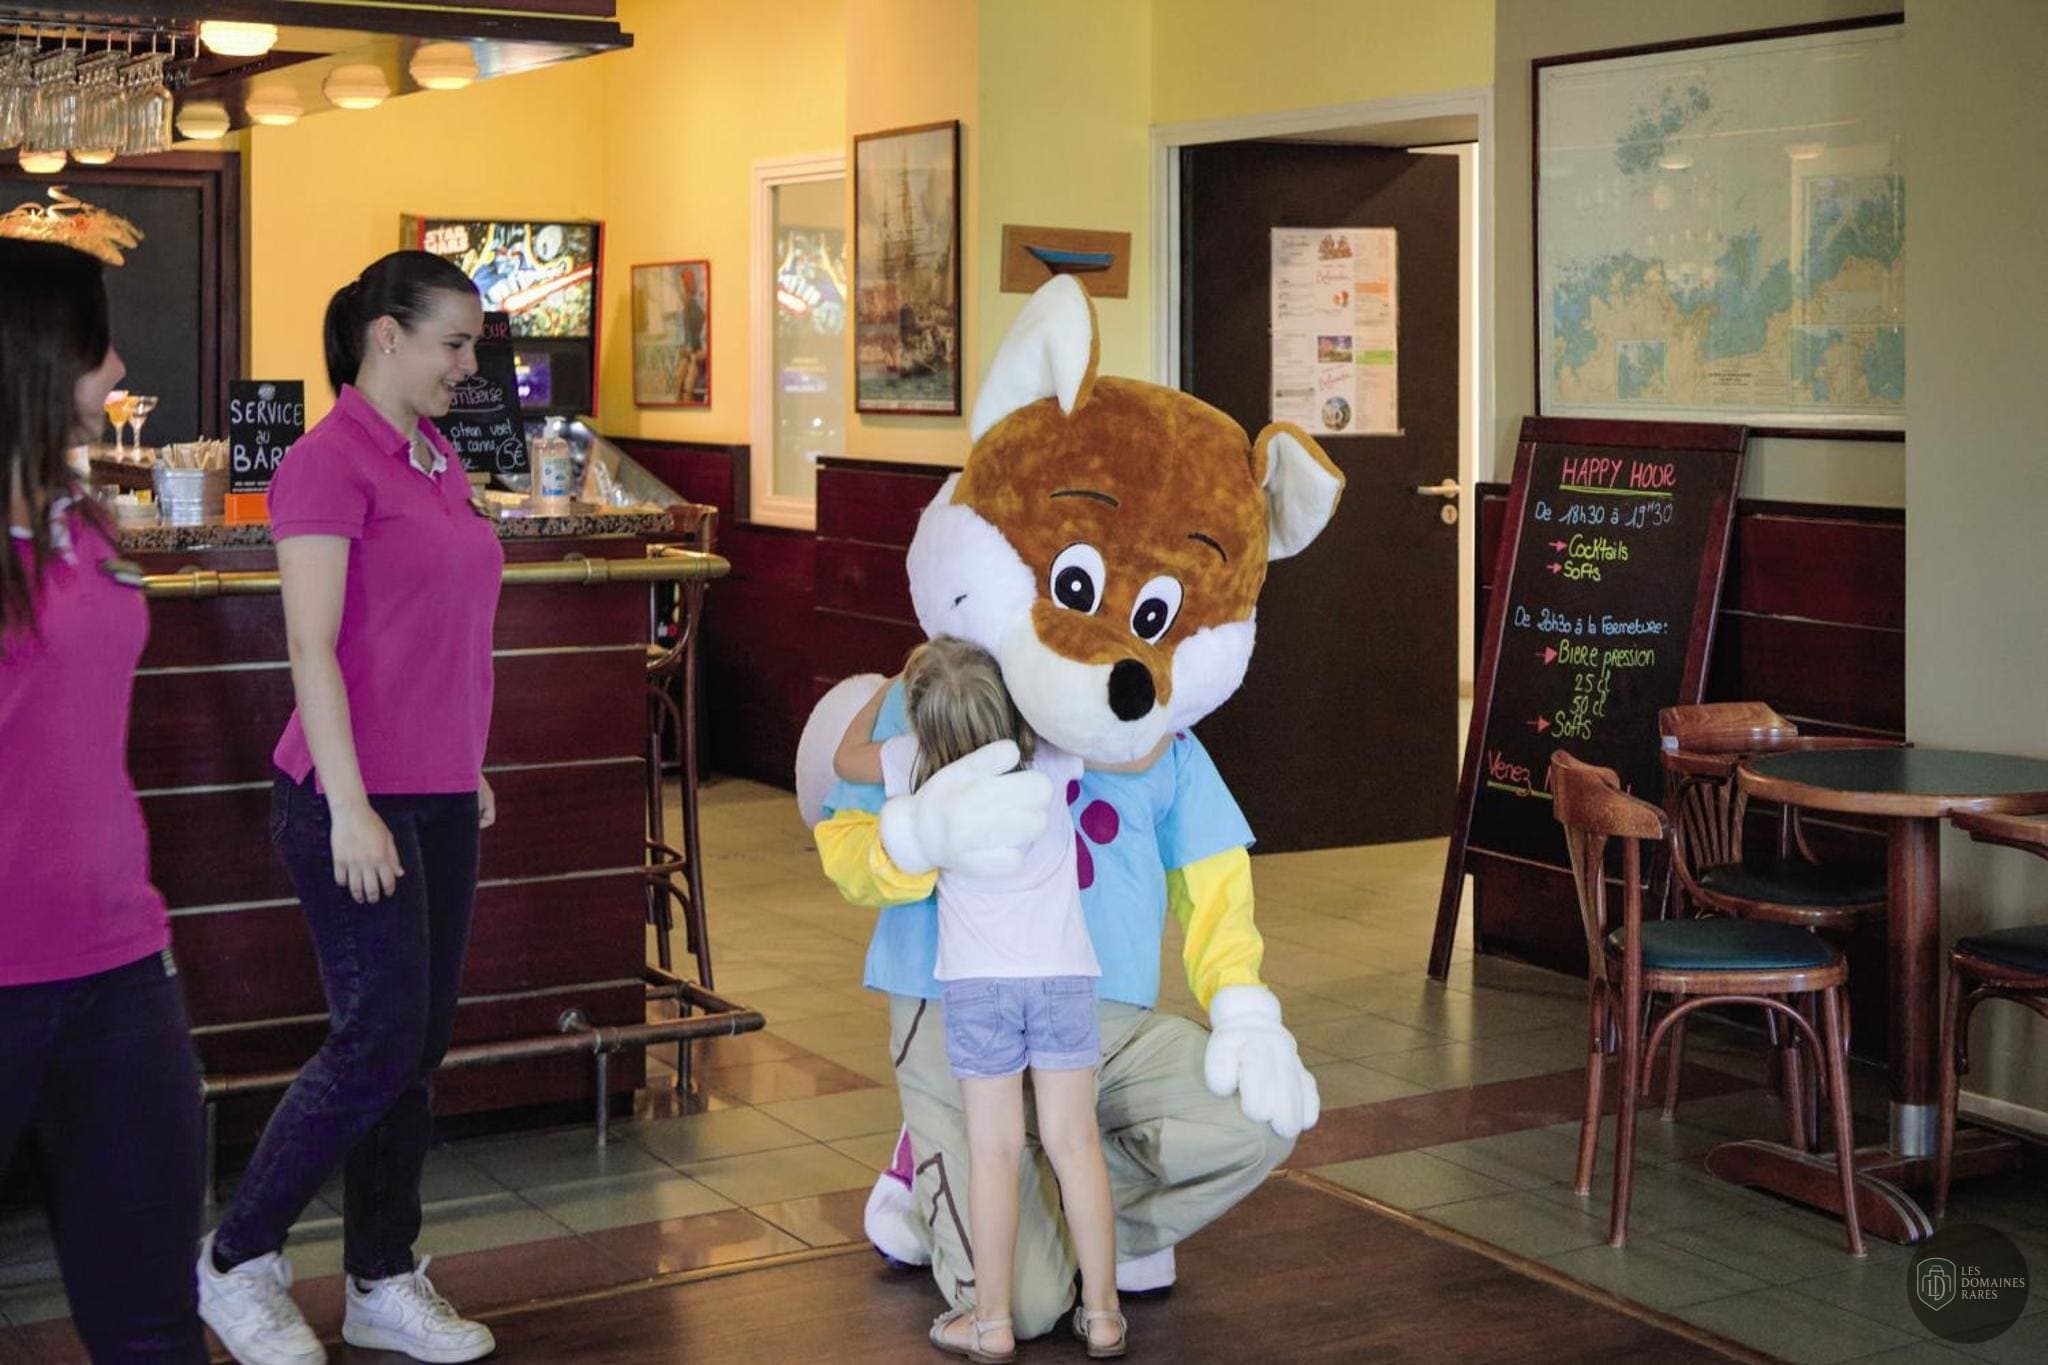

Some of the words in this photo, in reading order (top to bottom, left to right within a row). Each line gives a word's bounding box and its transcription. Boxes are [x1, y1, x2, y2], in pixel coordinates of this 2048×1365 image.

[230, 398, 304, 426] SERVICE
[256, 430, 271, 445] au
[1562, 457, 1623, 487] HAPPY
[1630, 460, 1677, 487] HOUR
[1535, 501, 1552, 521] De
[1558, 504, 1604, 525] 18h30
[1514, 605, 1530, 627] De
[1574, 673, 1594, 693] 25
[1488, 749, 1532, 797] Venez
